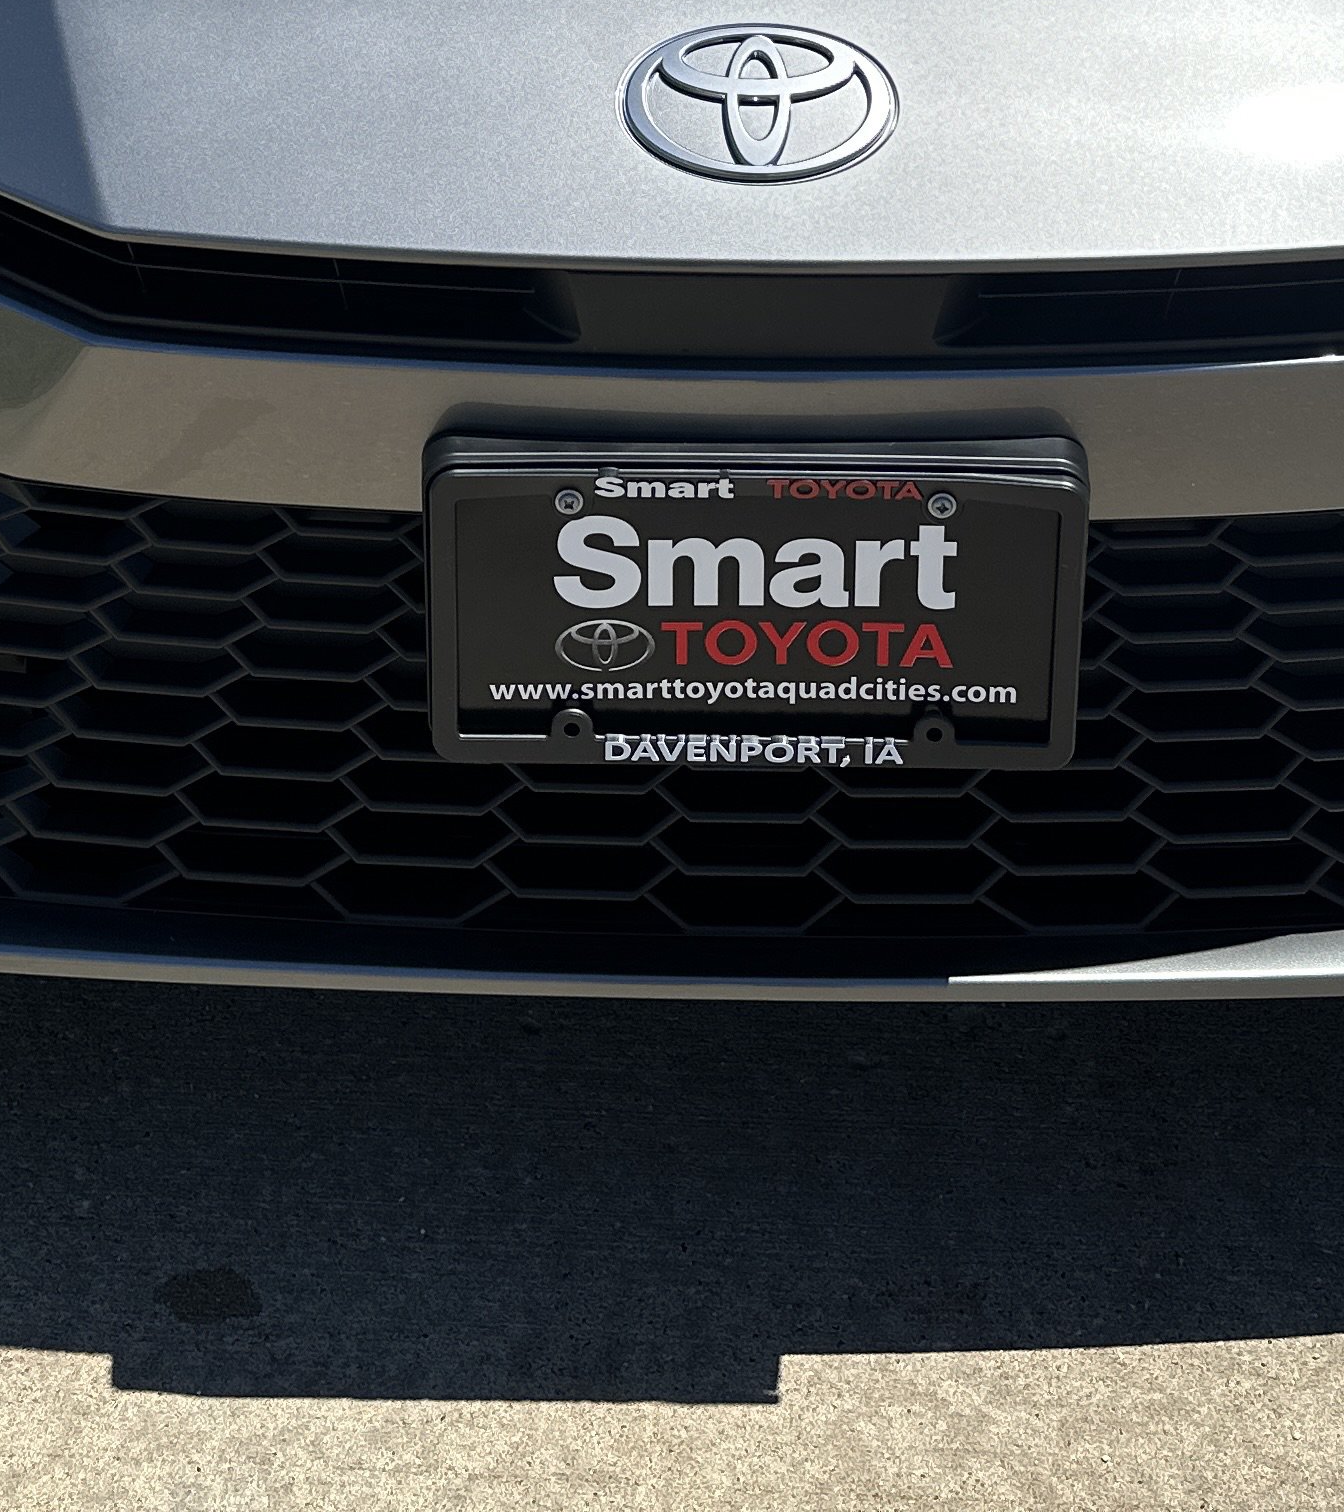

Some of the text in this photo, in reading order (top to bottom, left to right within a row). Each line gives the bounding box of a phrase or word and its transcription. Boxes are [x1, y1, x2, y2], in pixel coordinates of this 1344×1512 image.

[593, 475, 924, 502] Smart TOYOTA
[553, 515, 958, 610] Smart
[660, 619, 954, 669] TOYOTA
[489, 677, 1018, 705] www.smarttoyotaquadcities.com
[603, 737, 904, 767] DAVENPORT, IA
